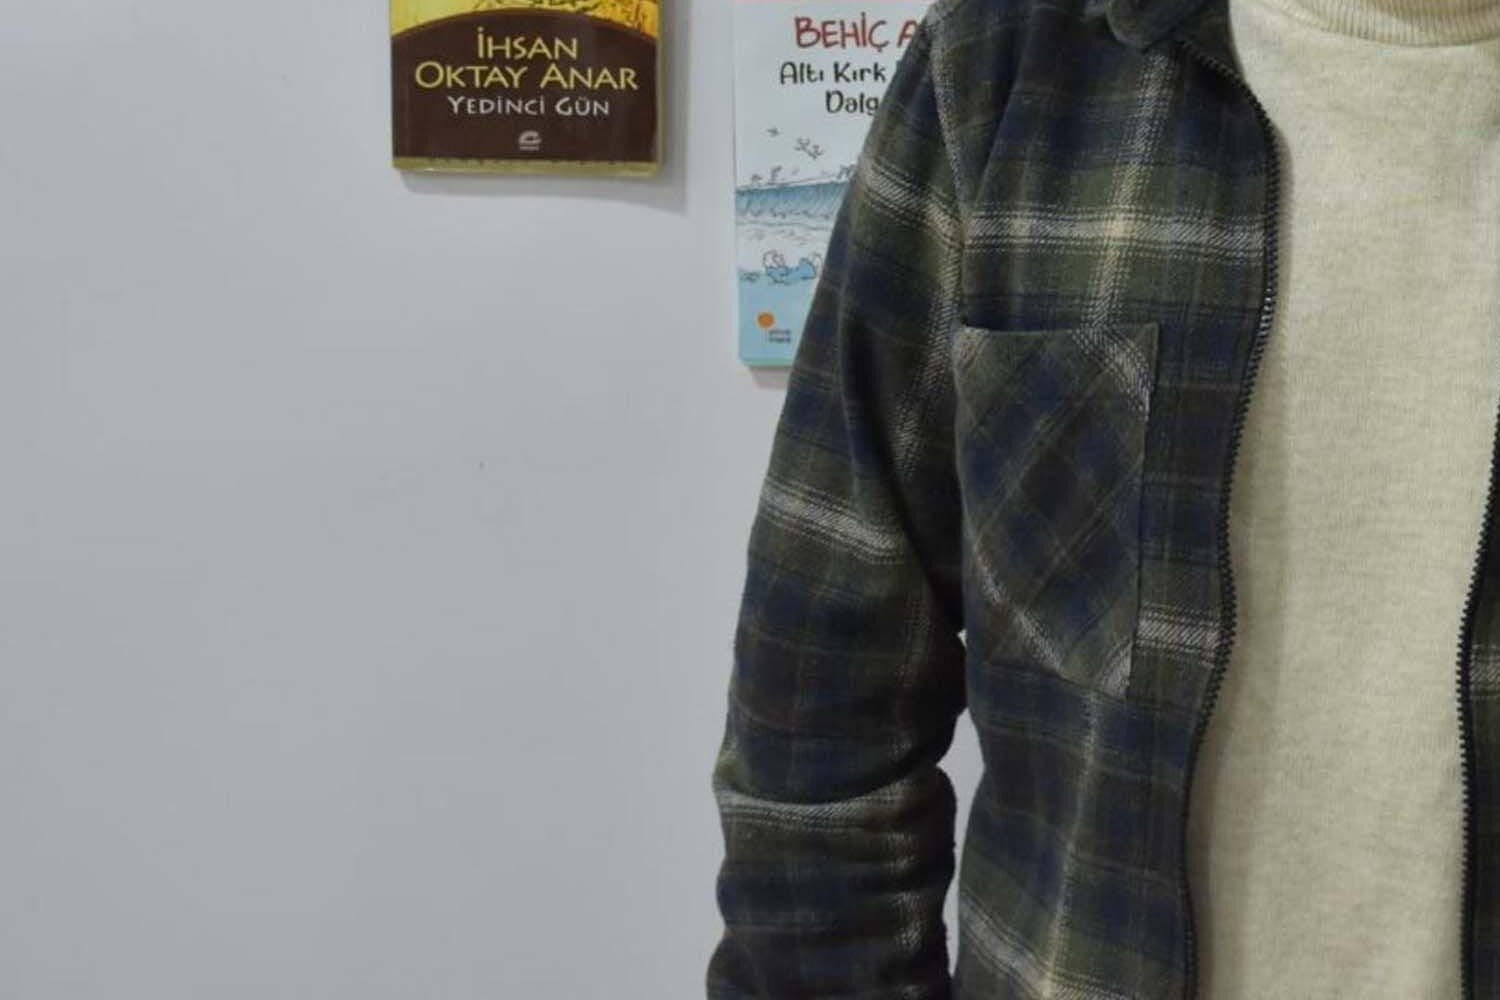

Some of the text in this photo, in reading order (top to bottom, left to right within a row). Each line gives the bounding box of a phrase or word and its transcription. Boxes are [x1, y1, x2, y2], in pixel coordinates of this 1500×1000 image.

[794, 11, 920, 52] BEHİÇ A
[415, 61, 639, 90] OKTAY ANAR
[780, 61, 886, 84] Altı Kırk
[448, 96, 609, 116] YEDİNCİ GÜN
